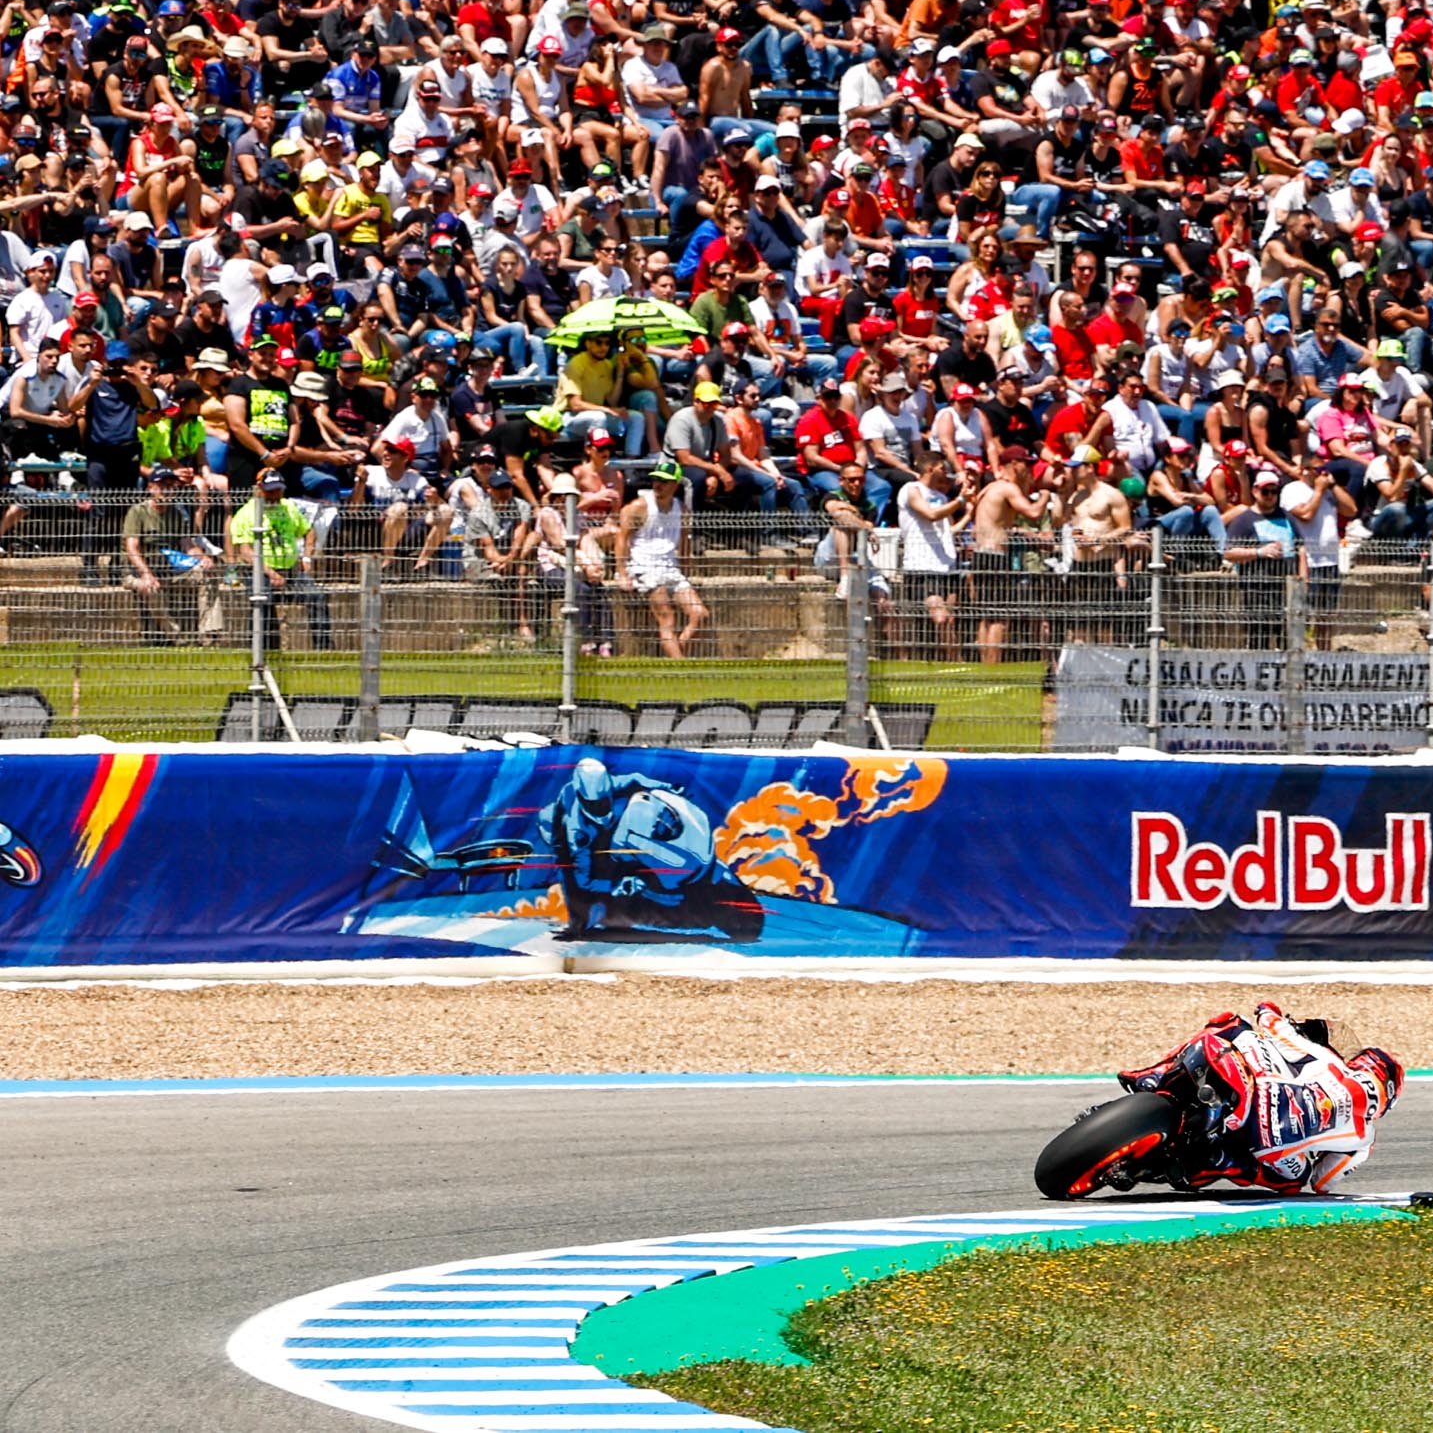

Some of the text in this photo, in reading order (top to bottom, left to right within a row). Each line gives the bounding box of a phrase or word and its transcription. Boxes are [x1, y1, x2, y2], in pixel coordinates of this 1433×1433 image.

[1222, 700, 1251, 730] TE
[1131, 810, 1430, 912] Red Bull
